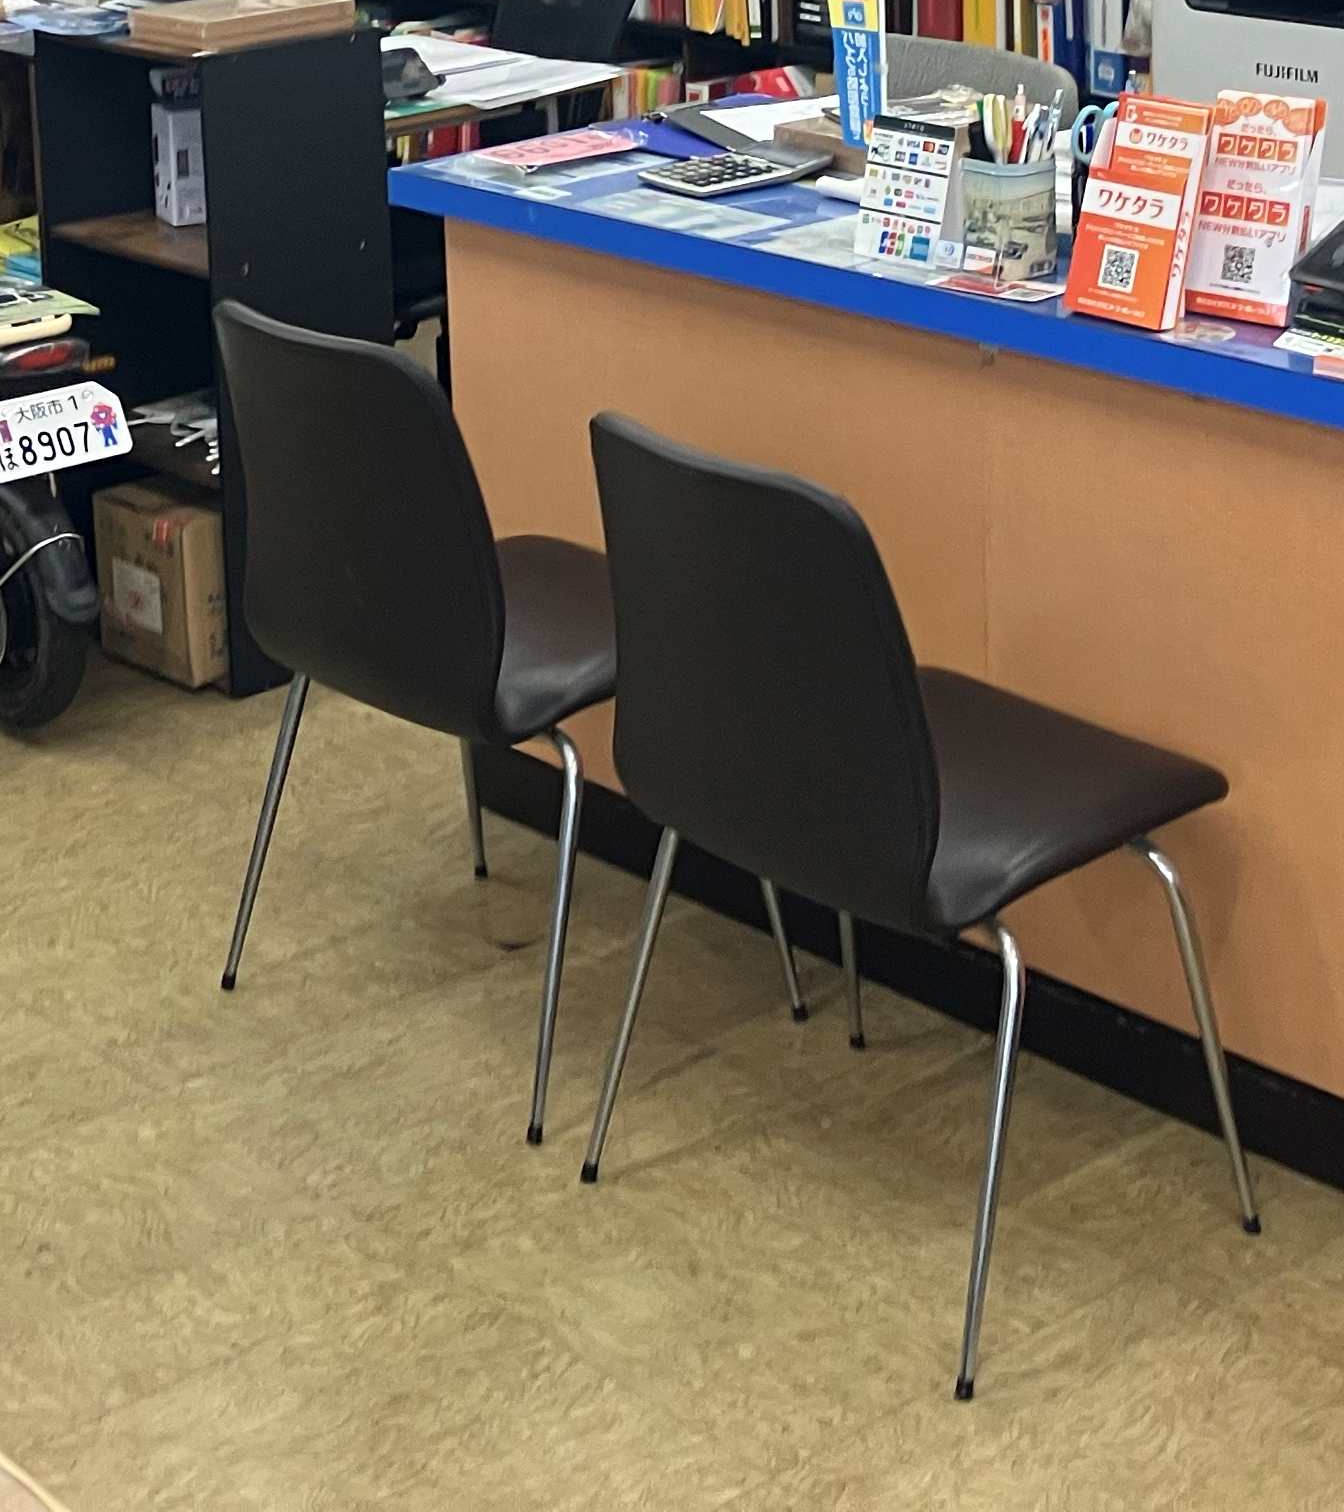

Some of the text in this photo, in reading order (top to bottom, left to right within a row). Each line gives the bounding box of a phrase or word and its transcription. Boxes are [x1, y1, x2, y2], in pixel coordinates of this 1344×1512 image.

[1256, 62, 1318, 83] FUJIFILM
[907, 140, 921, 149] VISA
[1146, 132, 1188, 151] ワケタラ
[1220, 135, 1297, 159] ワケタラ
[1098, 188, 1165, 218] ワケタラ
[1202, 194, 1288, 224] ワケタラ
[16, 400, 63, 424] 大阪市
[19, 422, 88, 465] 8907
